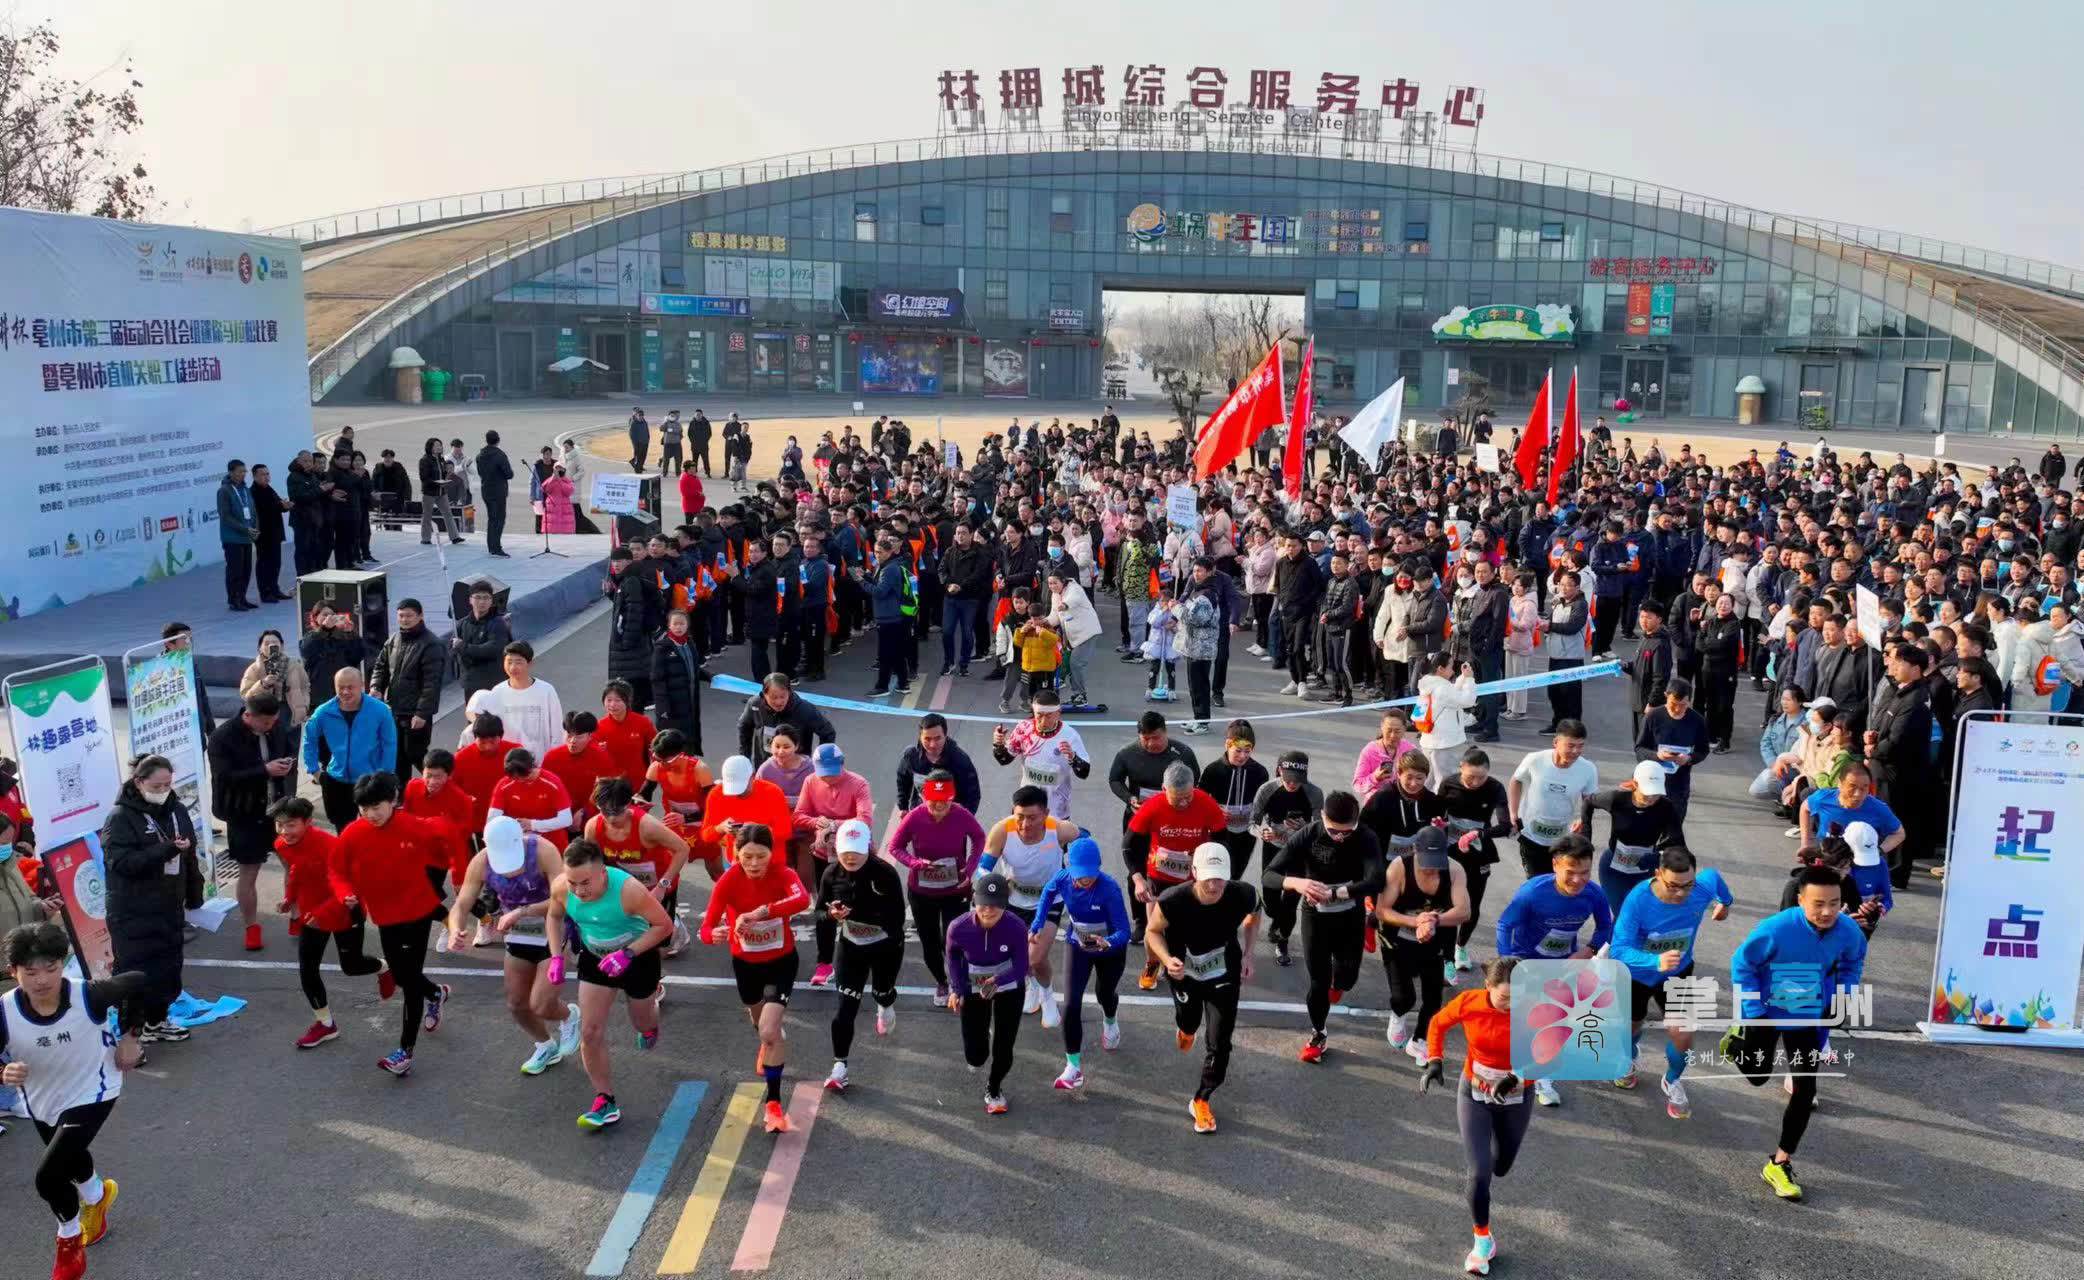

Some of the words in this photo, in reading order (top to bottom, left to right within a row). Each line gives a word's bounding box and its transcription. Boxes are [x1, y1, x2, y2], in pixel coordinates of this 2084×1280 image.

[938, 64, 1485, 128] 林拥城综合服务中心
[1207, 110, 1274, 125] Service
[1289, 114, 1352, 131] Center
[32, 319, 279, 348] 亳州市第三届运动会社会组迷你马拉松比赛
[42, 356, 222, 392] 暨亳州市直机关职工徒步活动
[27, 716, 97, 752] 林趣露营地
[1028, 770, 1054, 783] M010
[1983, 806, 2056, 959] 起点
